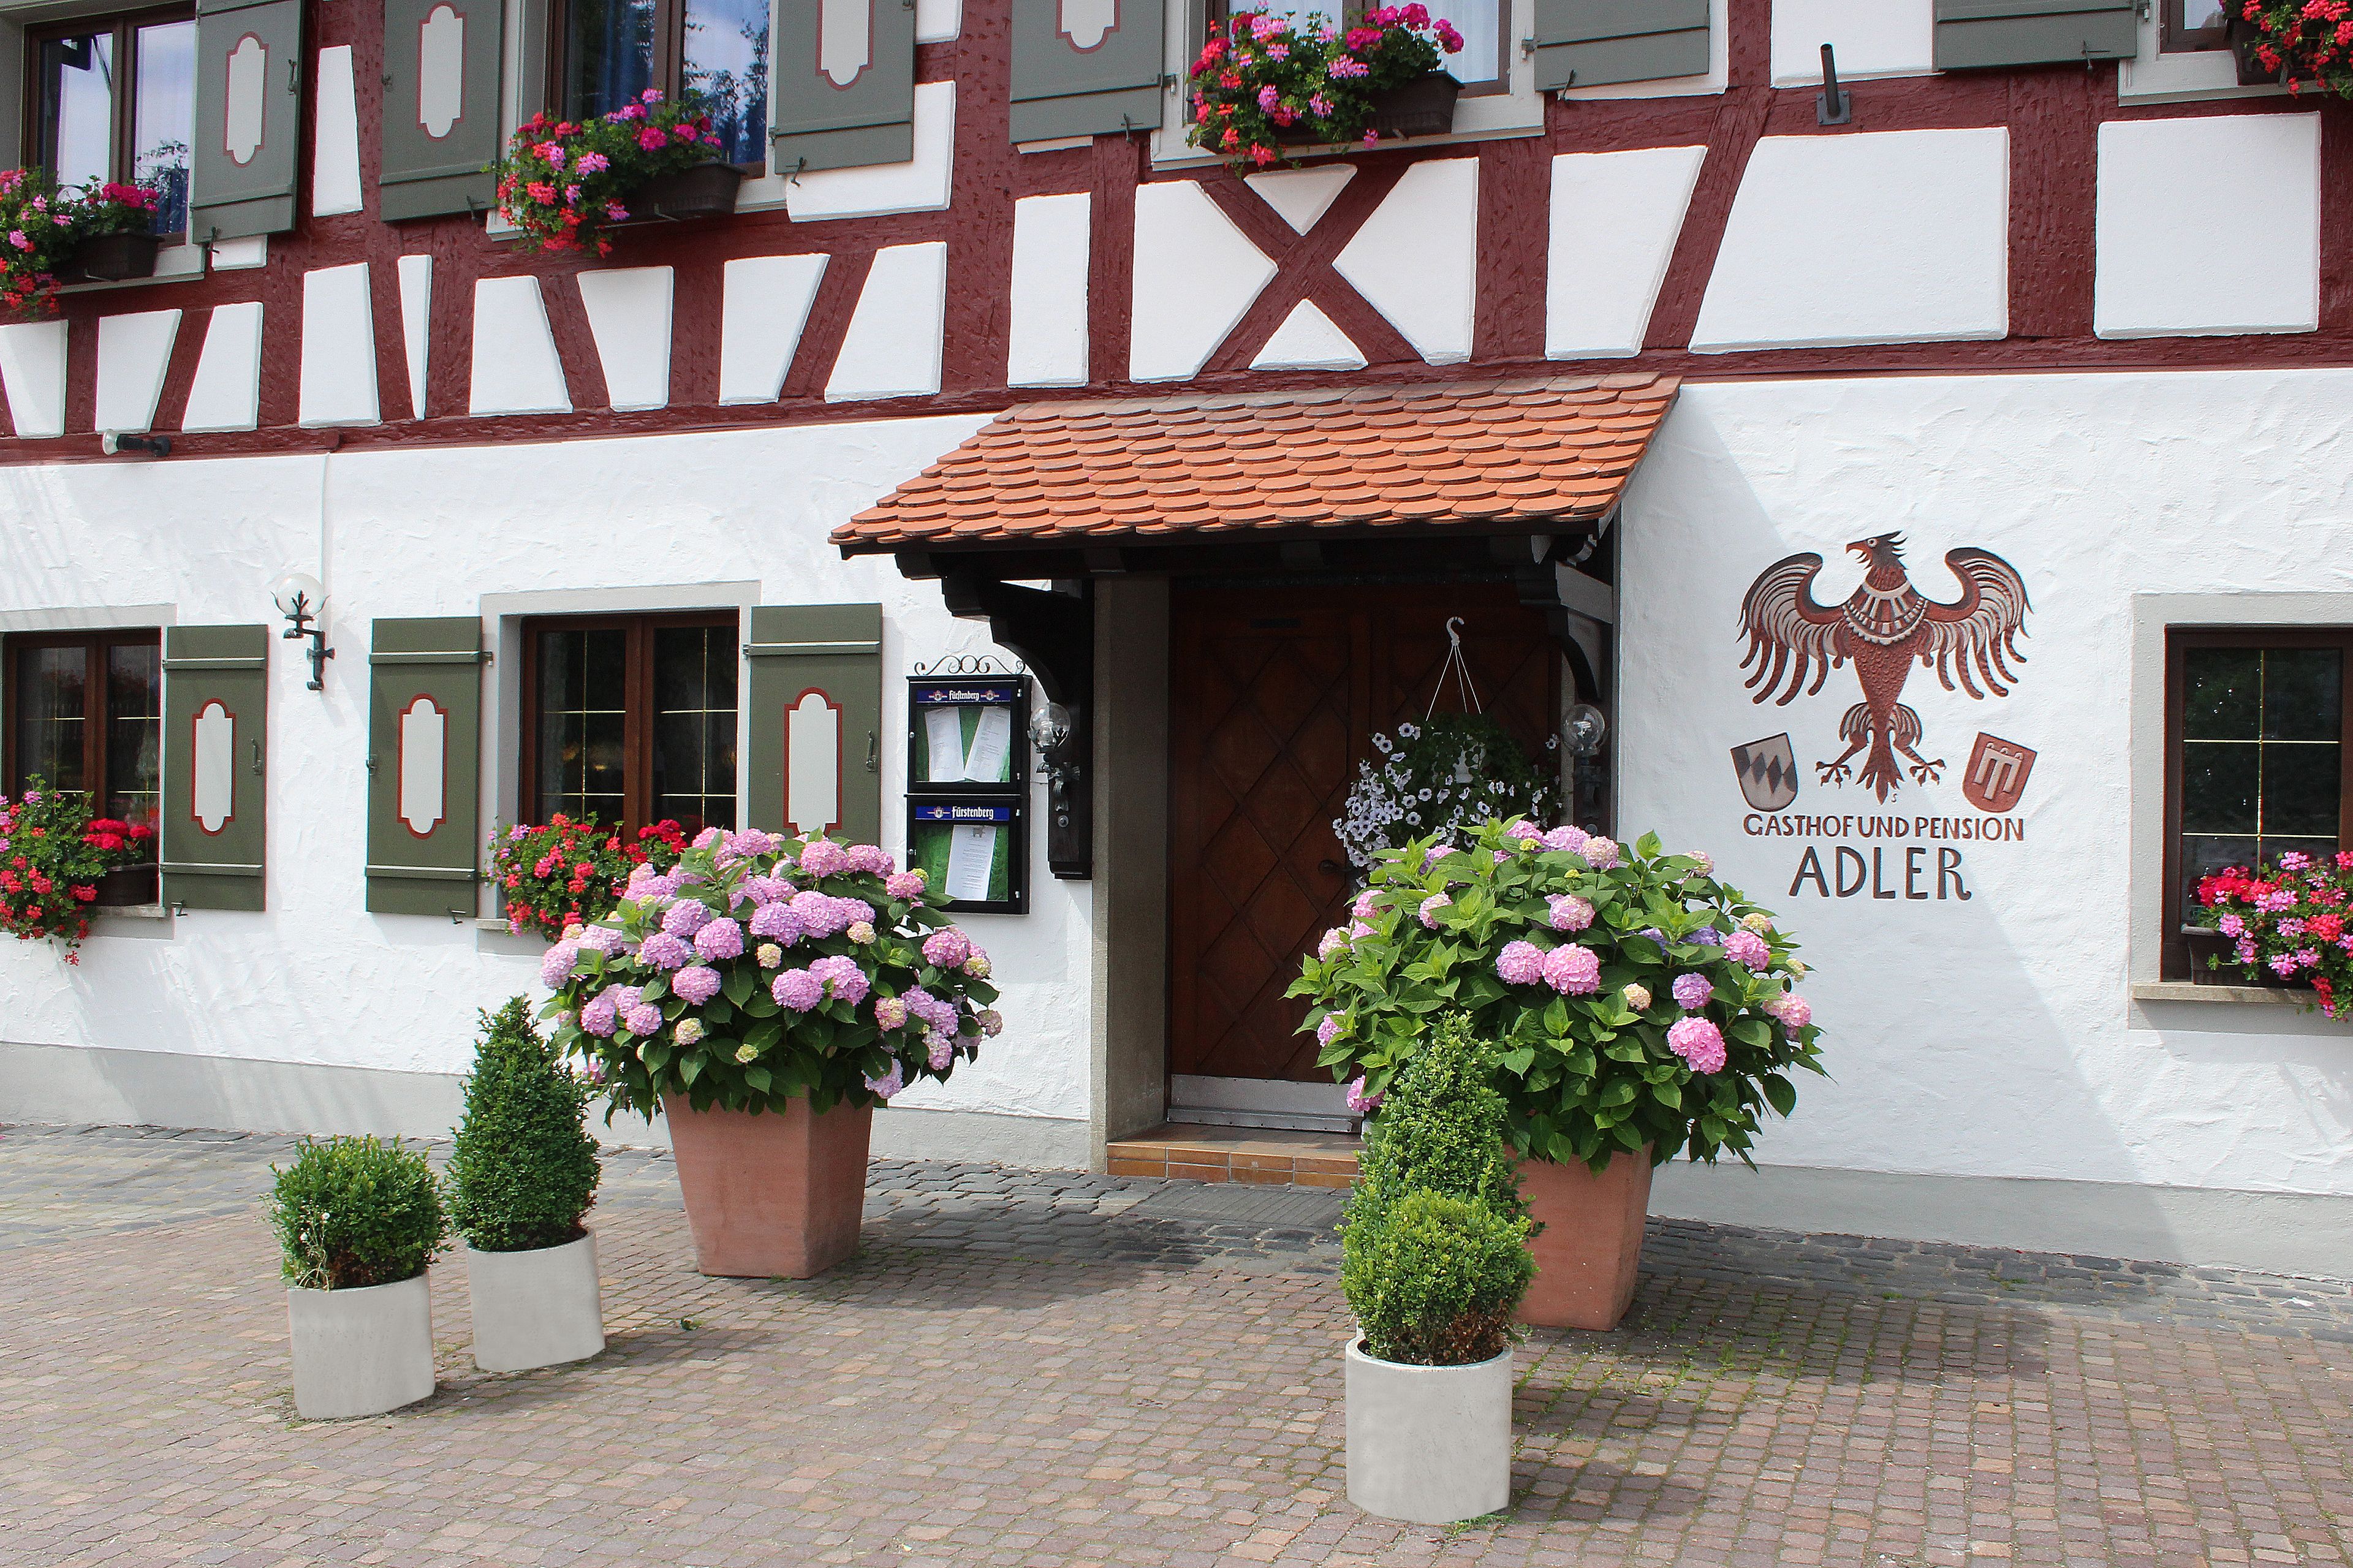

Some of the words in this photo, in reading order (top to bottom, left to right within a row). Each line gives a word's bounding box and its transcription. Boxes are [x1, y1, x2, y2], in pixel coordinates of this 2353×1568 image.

[952, 806, 994, 820] Fürstenberg
[1743, 814, 1854, 837] GASTHOF
[1857, 816, 1909, 838] UND
[1915, 817, 2025, 841] PENSION
[1789, 846, 1972, 901] ADLER
